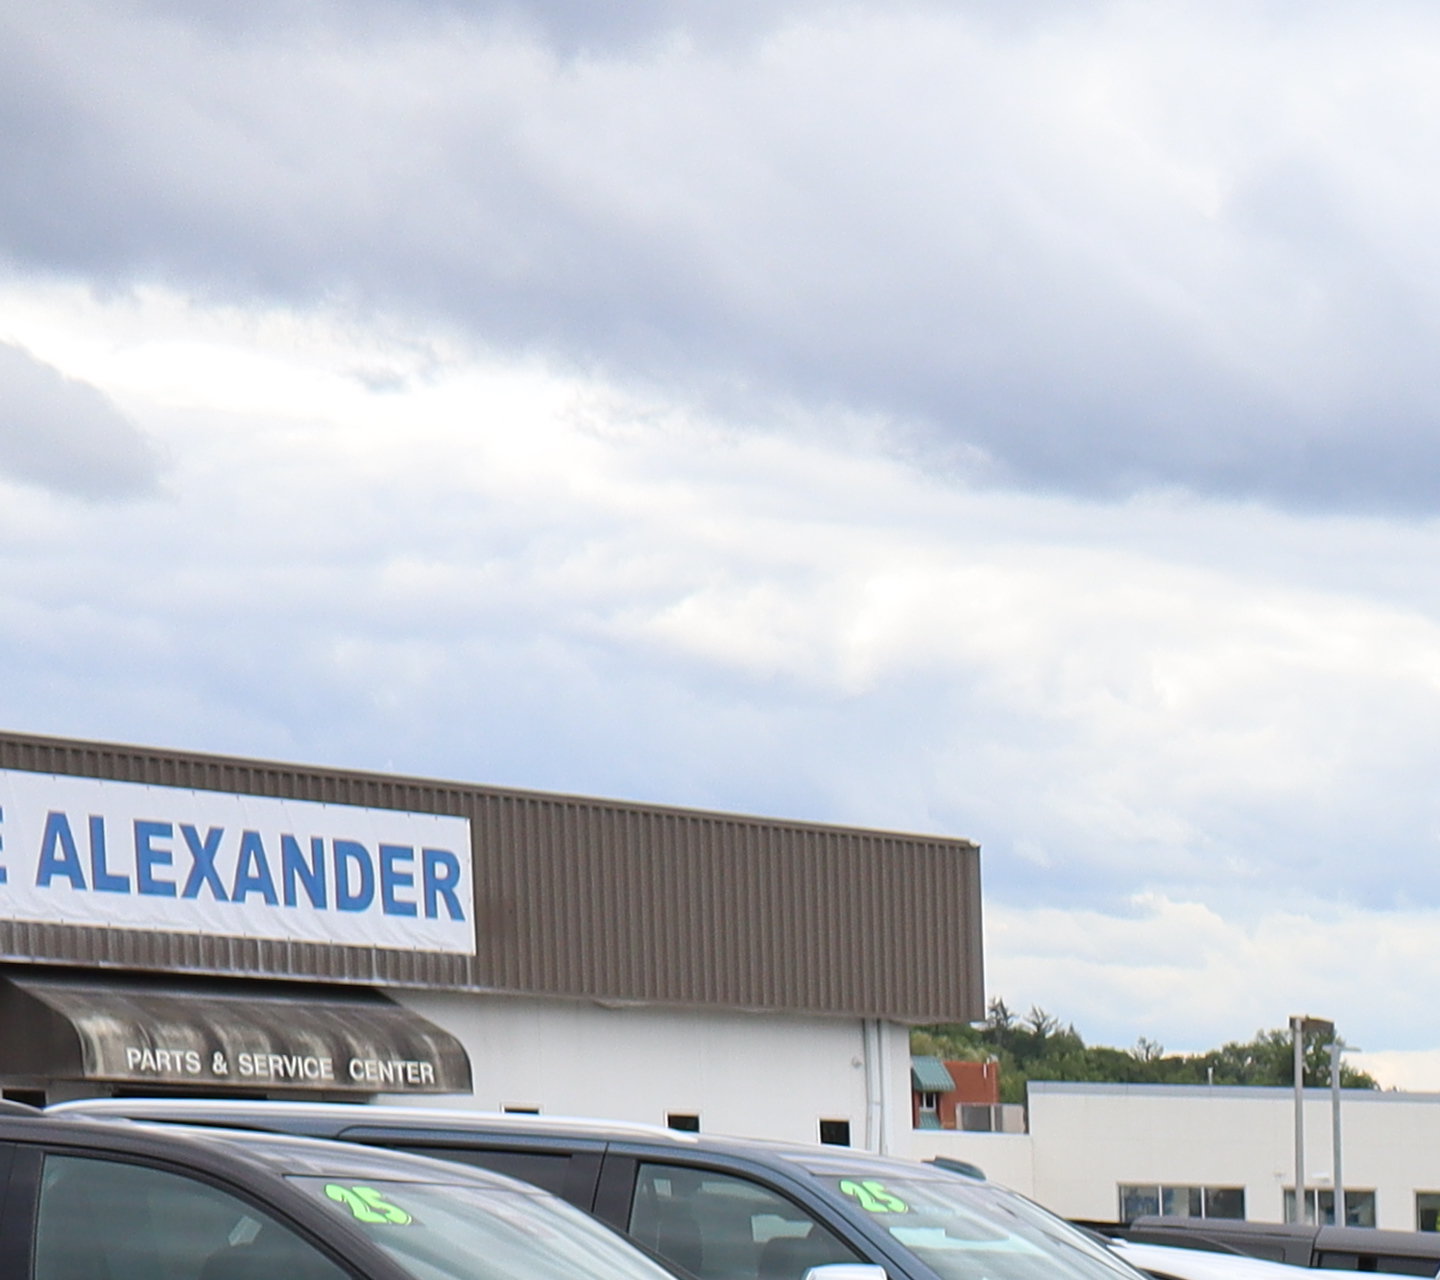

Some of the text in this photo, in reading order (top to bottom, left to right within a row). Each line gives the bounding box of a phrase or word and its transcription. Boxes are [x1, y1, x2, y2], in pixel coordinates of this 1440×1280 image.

[35, 809, 467, 923] ALEXANDER
[126, 1047, 436, 1084] PARTS & SERVICE CENTER
[323, 1183, 413, 1225] 25
[839, 1179, 909, 1214] 25
